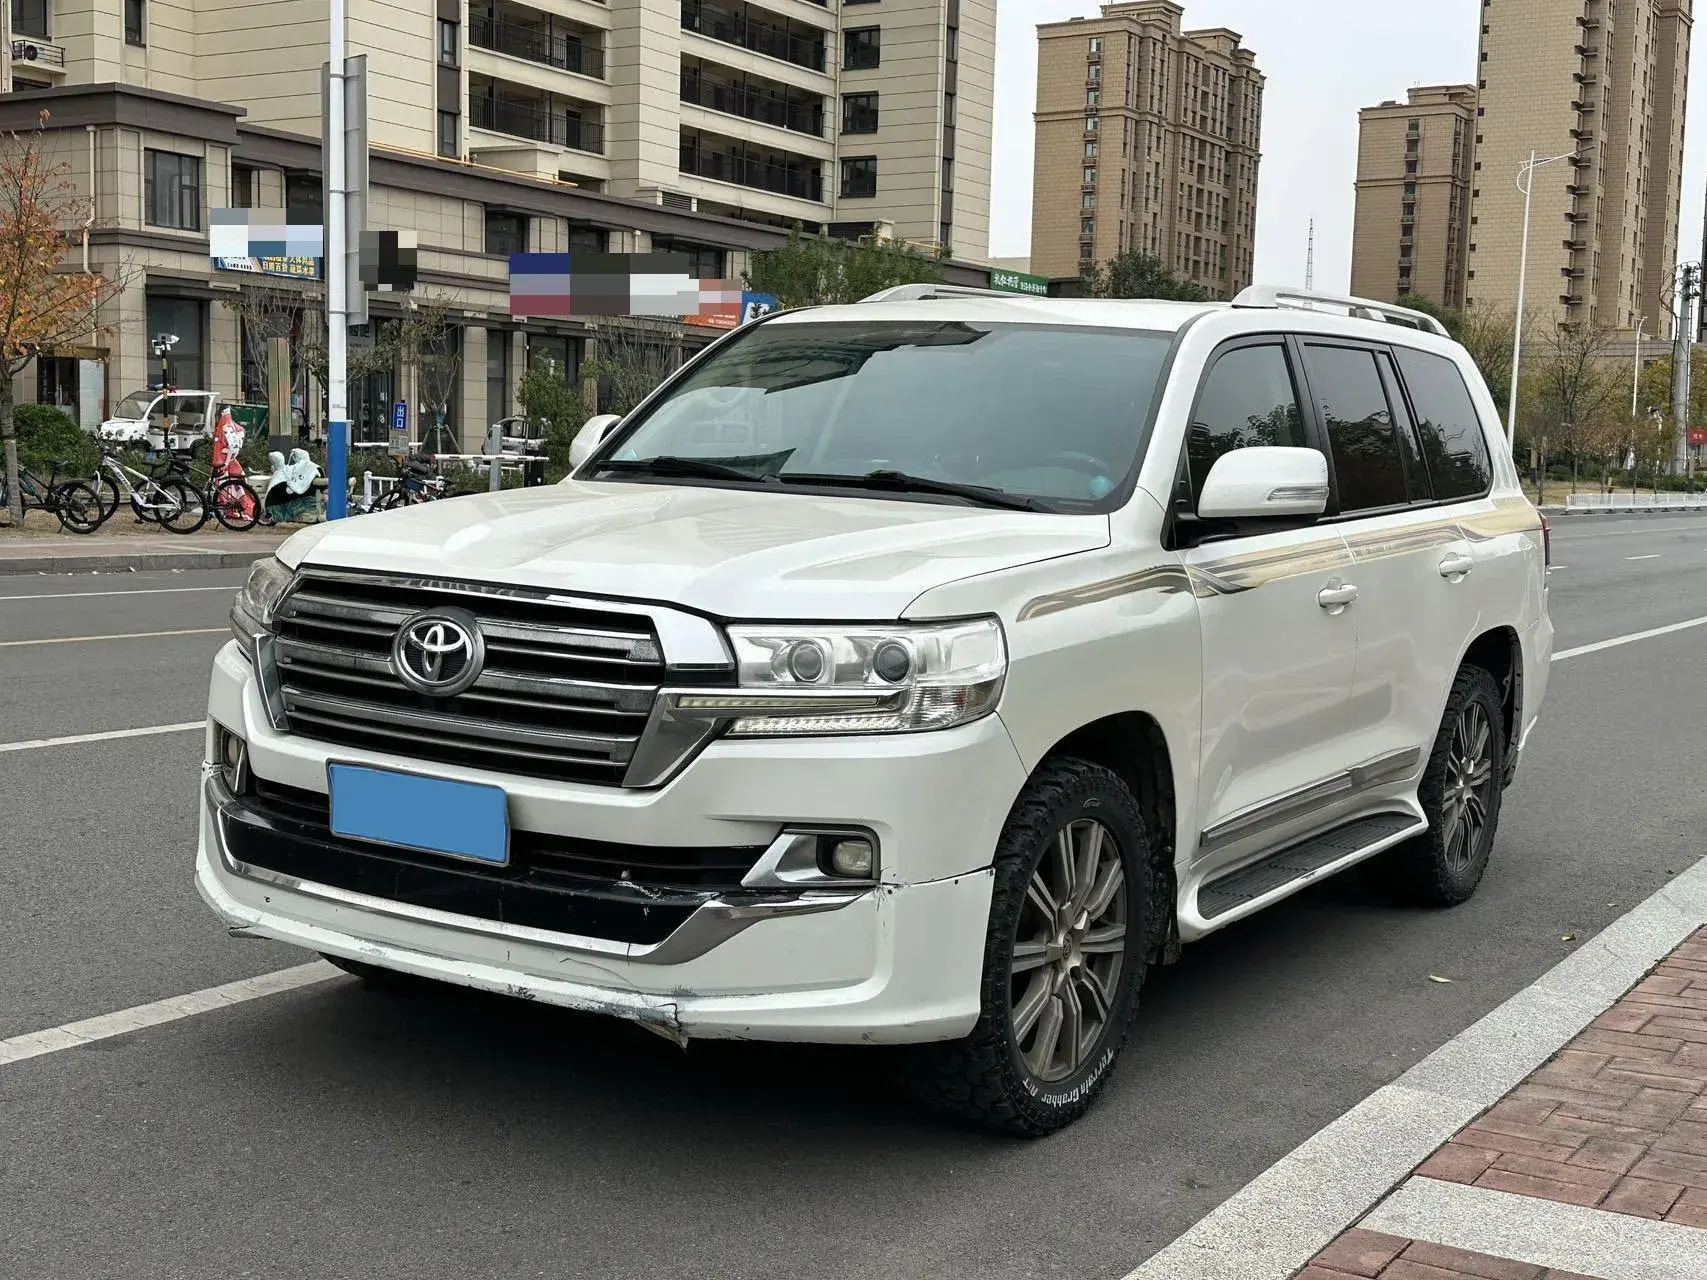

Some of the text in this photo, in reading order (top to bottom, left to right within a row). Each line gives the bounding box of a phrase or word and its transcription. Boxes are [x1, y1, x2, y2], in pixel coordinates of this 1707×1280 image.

[396, 405, 405, 428] 出口
[1080, 1047, 1115, 1095] Terrain
[1041, 1087, 1080, 1108] Grabber
